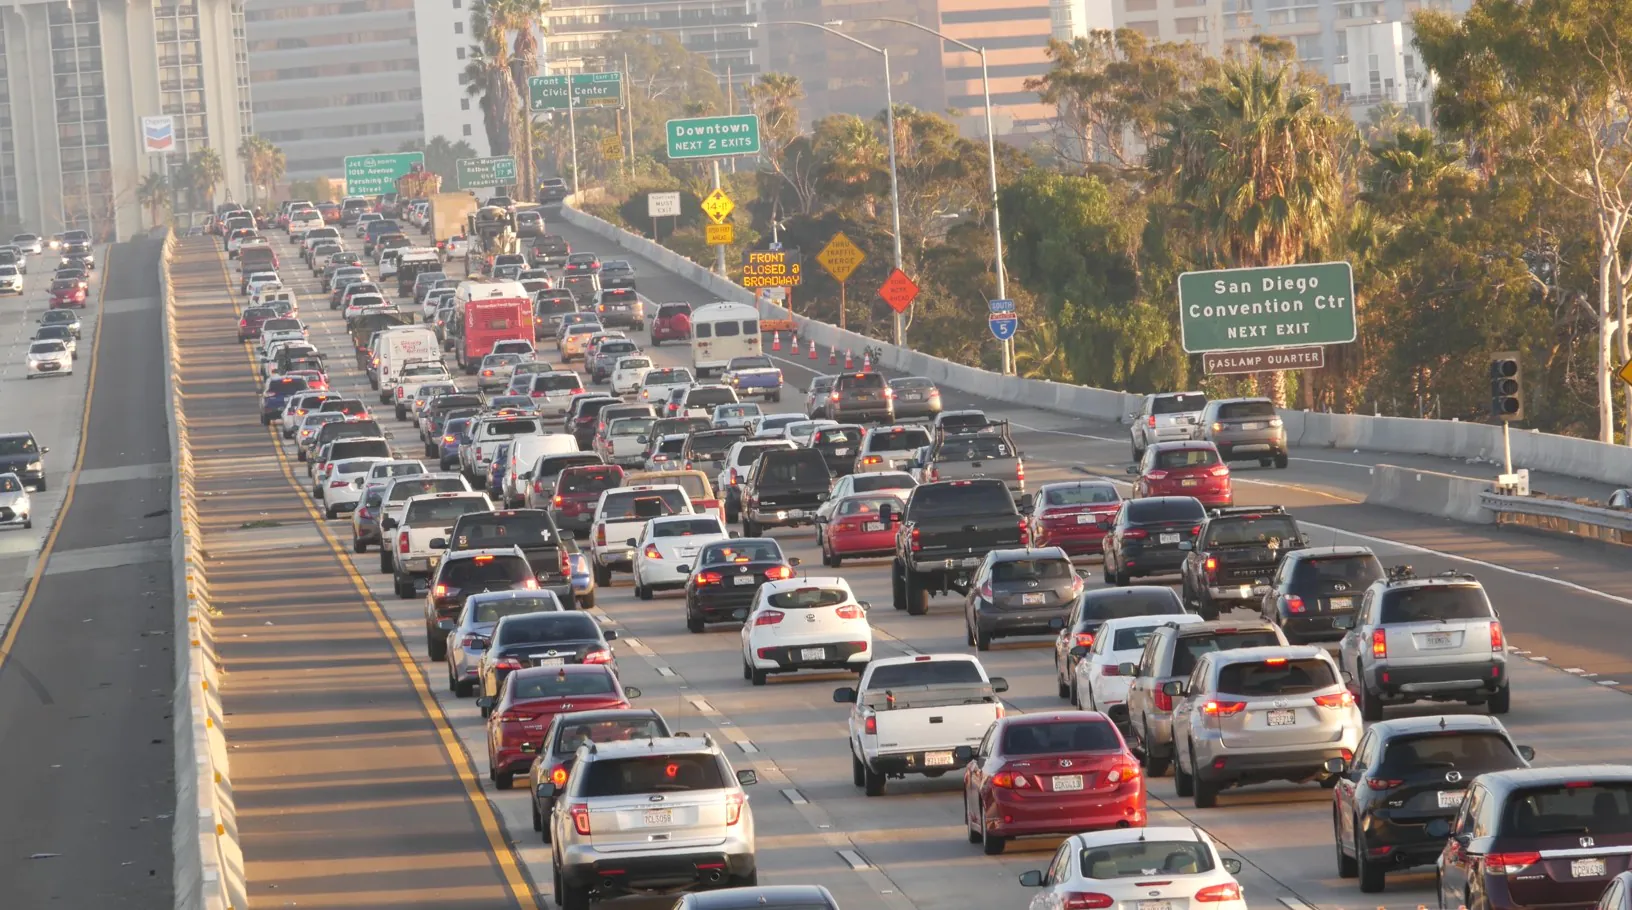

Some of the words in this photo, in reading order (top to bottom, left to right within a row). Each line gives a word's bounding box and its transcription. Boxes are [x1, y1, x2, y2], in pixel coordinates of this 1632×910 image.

[533, 77, 558, 86] Front
[564, 76, 575, 84] St
[542, 88, 568, 97] Civic
[574, 86, 608, 95] Center
[676, 123, 749, 137] Downtown
[606, 145, 620, 154] 45
[675, 140, 703, 150] NEXT
[708, 139, 717, 149] 2
[721, 137, 752, 147] EXITS
[750, 252, 785, 263] FRONT
[828, 257, 856, 265] MERGE
[743, 263, 786, 275] CLOSED
[792, 263, 800, 274] @
[743, 275, 800, 287] BROADWAY
[1214, 280, 1251, 294] San
[1262, 276, 1319, 294] Diego
[991, 301, 1013, 310] SOUTH
[1189, 298, 1303, 318] Convention
[1314, 295, 1345, 310] Ctr
[1000, 323, 1008, 335] 5
[1227, 325, 1267, 339] NEXT
[1276, 322, 1310, 335] EXIT
[1208, 356, 1262, 369] GASLAMP
[1267, 352, 1319, 364] QUARTER
